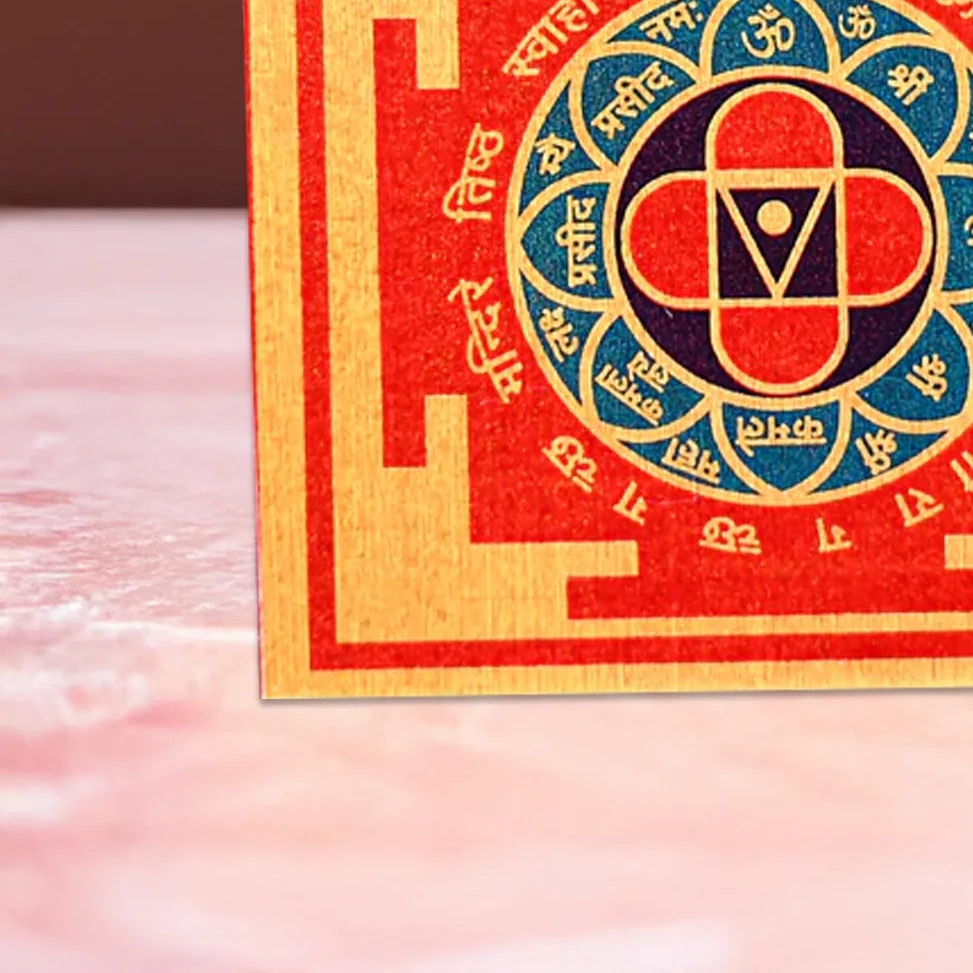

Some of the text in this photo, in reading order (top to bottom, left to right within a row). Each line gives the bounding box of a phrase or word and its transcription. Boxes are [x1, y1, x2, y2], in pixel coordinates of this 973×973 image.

[741, 4, 795, 58] ॐ
[839, 5, 875, 39] ॐ
[591, 61, 674, 139] प्रसीद
[442, 123, 504, 223] तिष्ठ
[555, 195, 597, 288] प्रसीद
[735, 416, 827, 456] कमले
